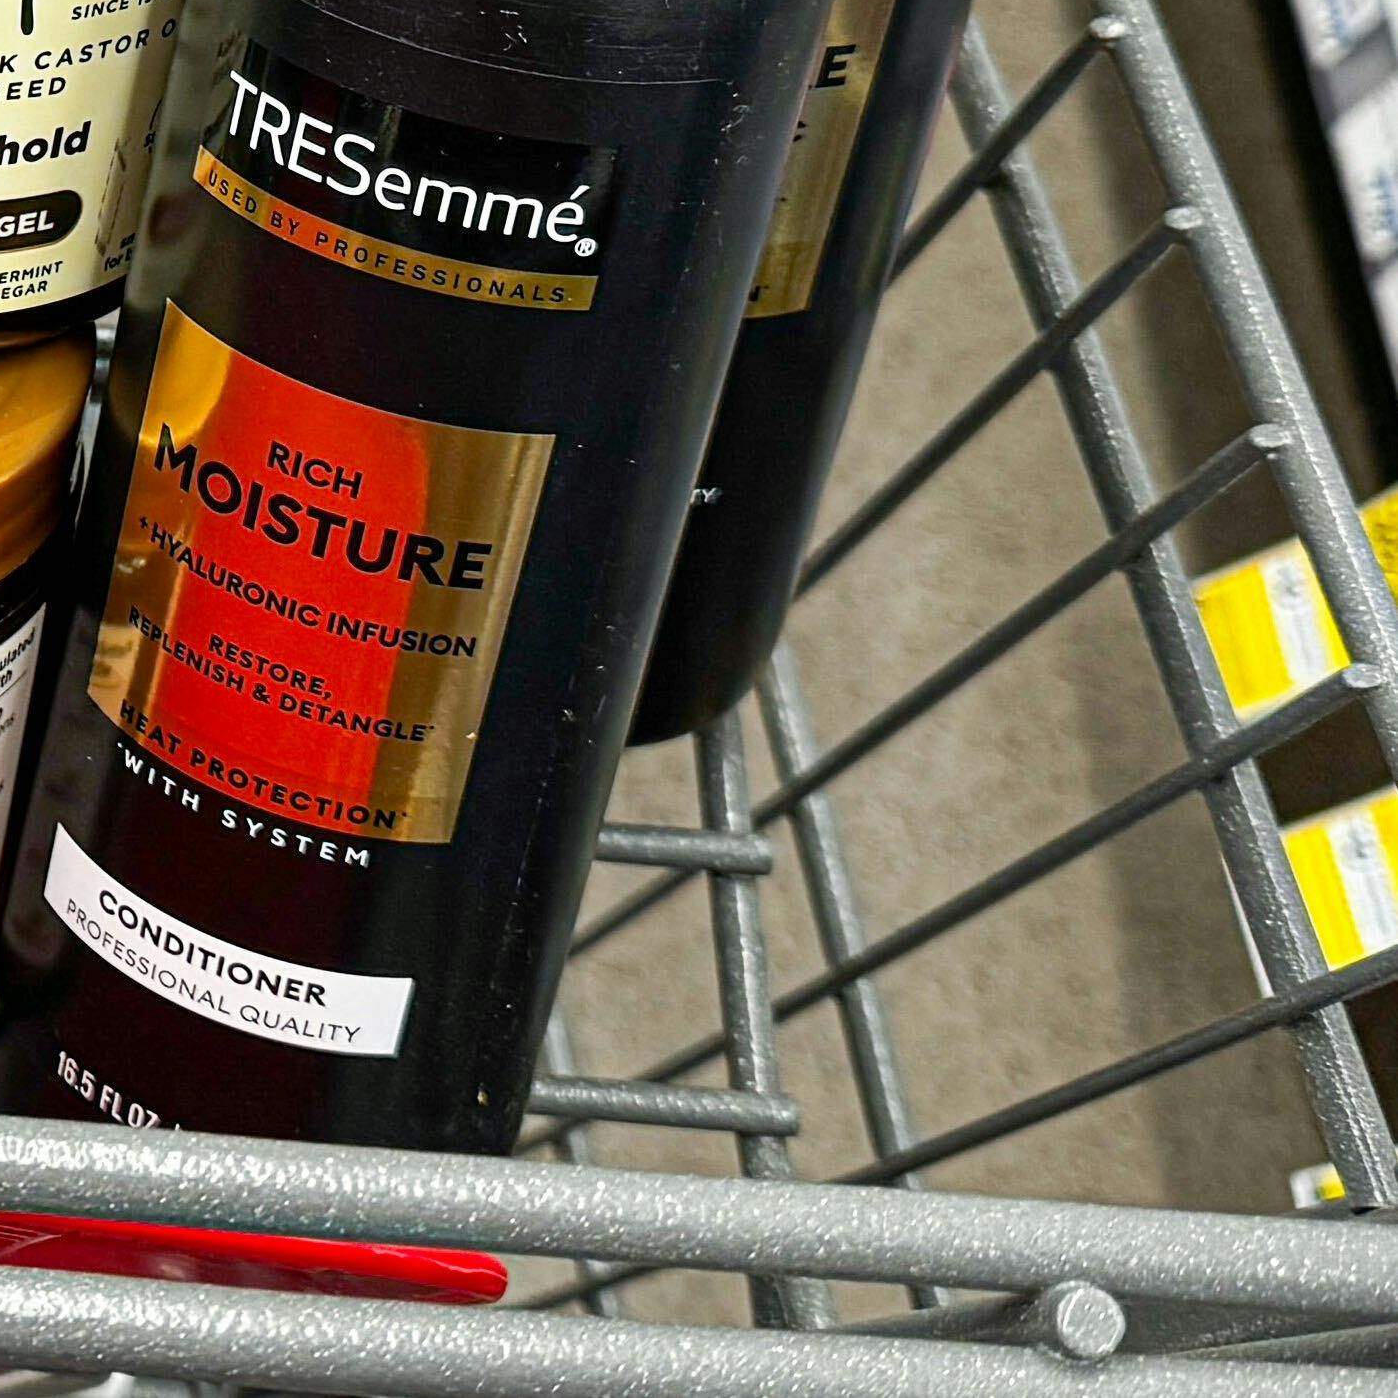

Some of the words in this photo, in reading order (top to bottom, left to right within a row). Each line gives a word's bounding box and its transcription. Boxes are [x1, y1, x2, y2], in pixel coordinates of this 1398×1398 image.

[34, 29, 150, 70] CASTOR
[208, 169, 258, 216] USED
[271, 210, 301, 236] BY
[314, 231, 567, 303] PROFESSIONALS
[153, 422, 493, 591] MOISTURE
[266, 441, 365, 500] RICH
[150, 526, 321, 629] HYALURONIC
[326, 613, 477, 658] INFUSION
[128, 604, 245, 694] REPLENISH
[251, 683, 271, 704] &
[209, 633, 333, 700] RESTORE,
[119, 701, 182, 756] HEAT
[221, 809, 372, 869] SYSTEM
[66, 899, 231, 1016] PROFESSIONAL
[240, 1005, 361, 1045] QUALITY
[99, 889, 328, 1007] CONDITIONER
[56, 1051, 97, 1101] 16.5
[99, 1090, 124, 1125] FL
